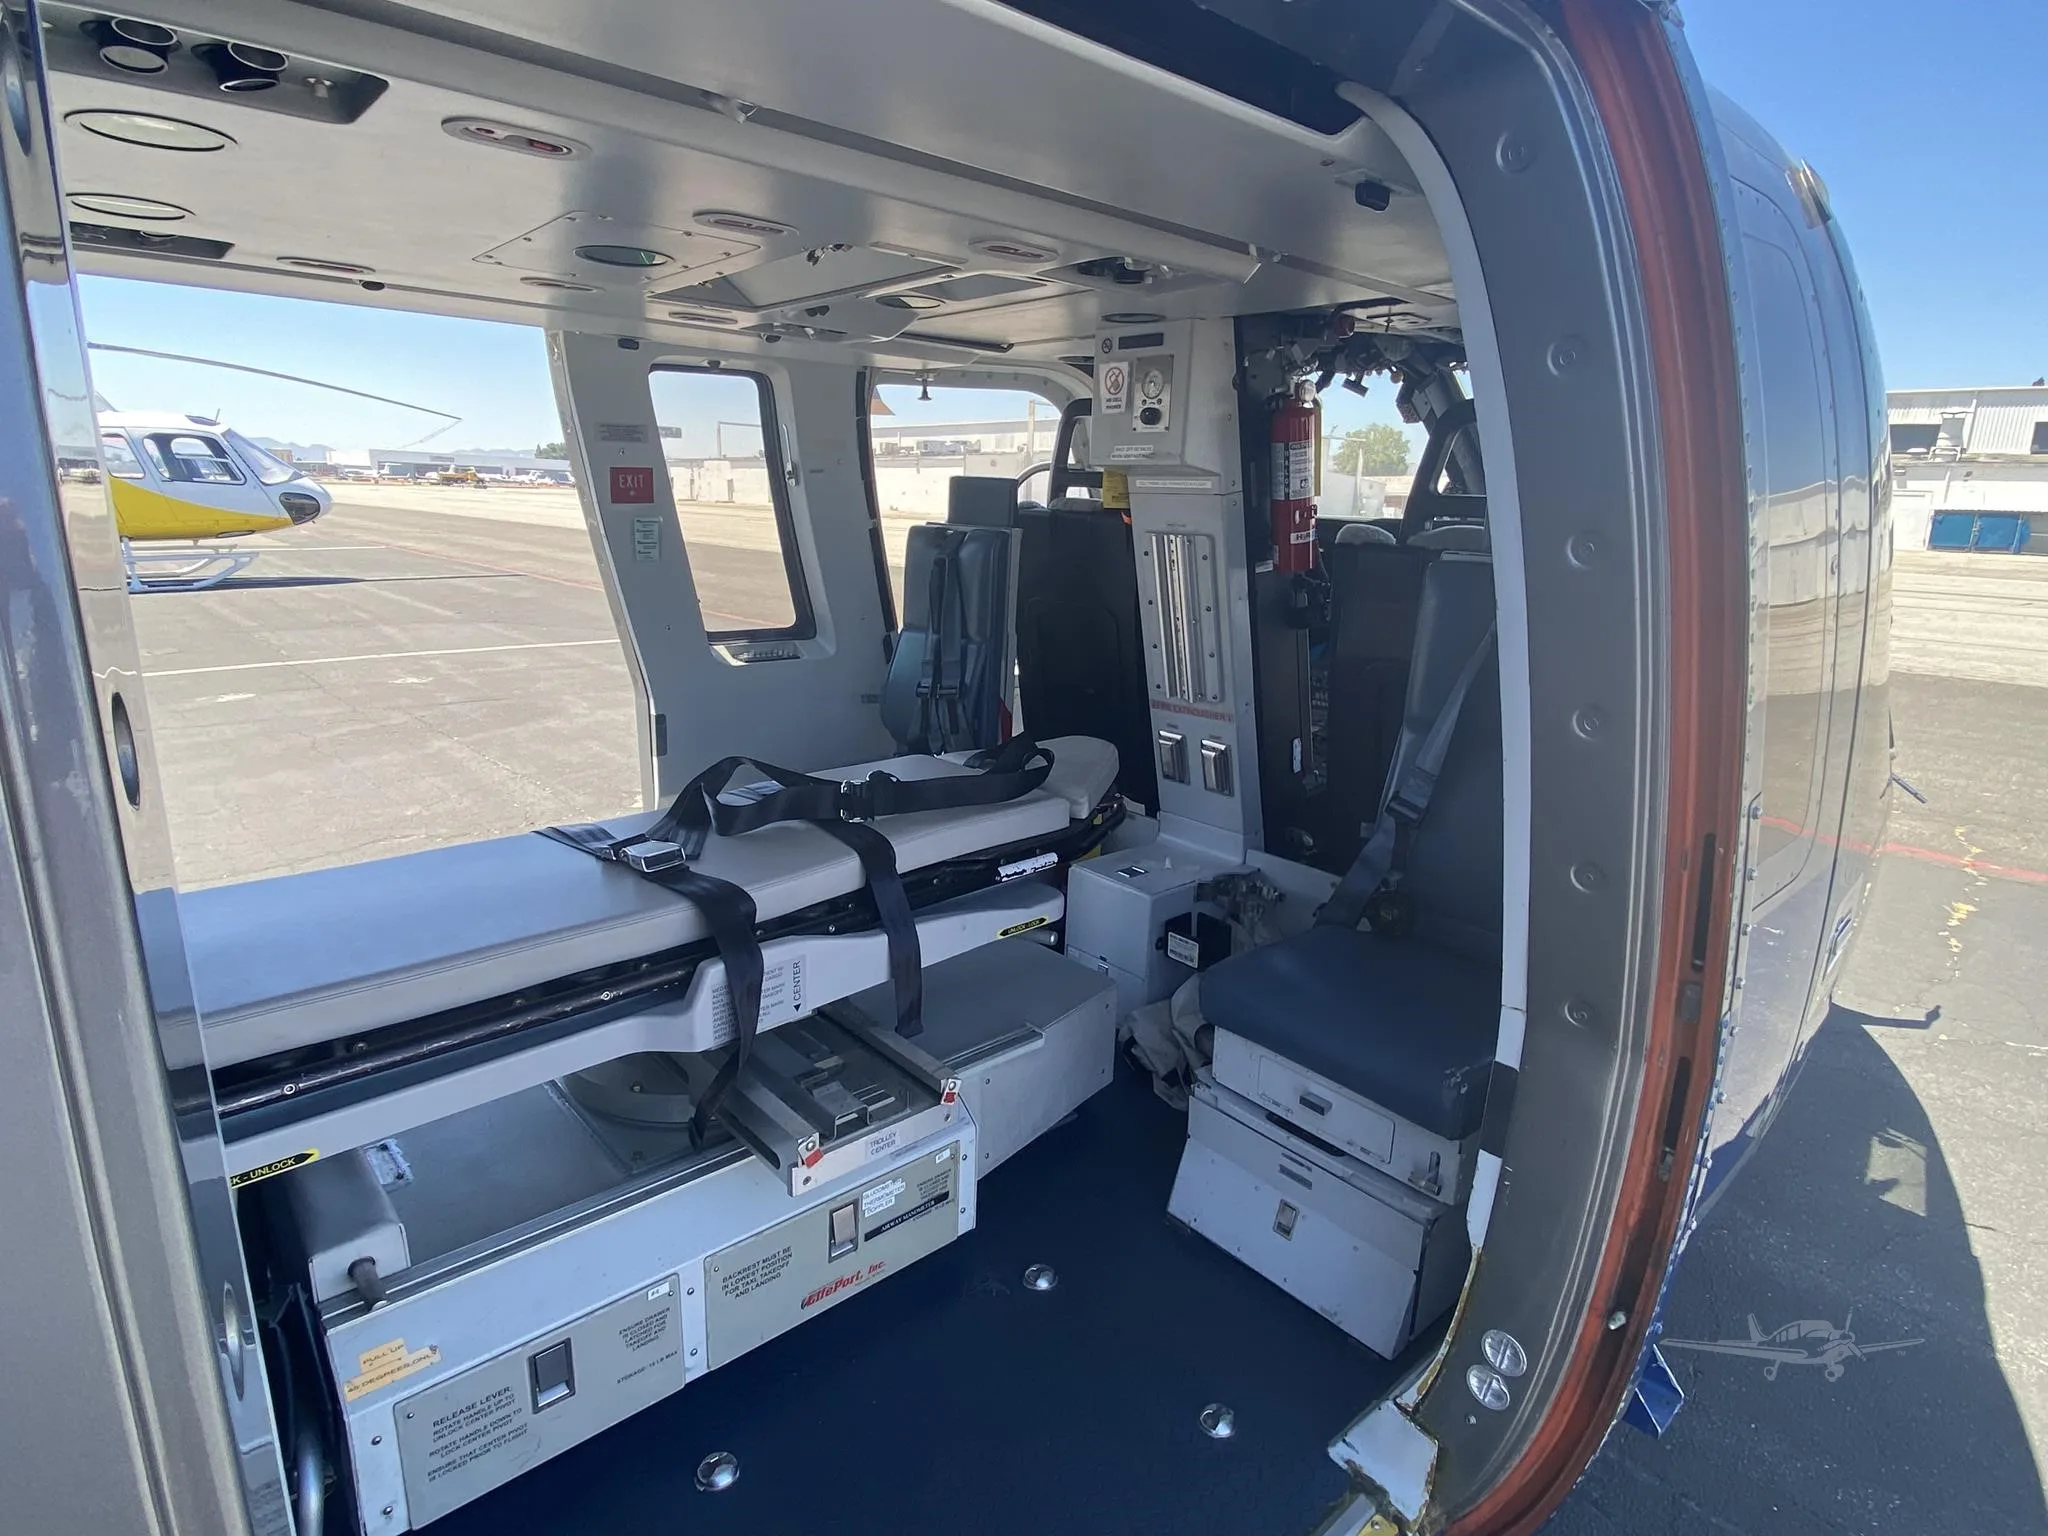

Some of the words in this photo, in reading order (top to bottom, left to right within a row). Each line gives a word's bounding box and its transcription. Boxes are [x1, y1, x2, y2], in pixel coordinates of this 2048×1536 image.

[619, 474, 644, 488] EXIT
[793, 960, 801, 1001] CENTER
[870, 1131, 897, 1148] TROLLEY
[870, 1140, 896, 1156] CENTER
[250, 1157, 296, 1179] UNLOCK
[722, 1262, 761, 1284] BACKREST
[761, 1252, 782, 1266] MUST
[782, 1246, 792, 1254] BE
[724, 1286, 740, 1297] FOR
[759, 1261, 790, 1280] TAKEOFF
[730, 1271, 759, 1288] LOWEST
[760, 1252, 793, 1272] POSITION
[734, 1288, 750, 1299] AND
[751, 1272, 782, 1292] LANDING
[619, 1319, 644, 1335] ENSURE
[644, 1307, 671, 1323] DRAWER
[625, 1326, 653, 1343] LATCHED
[653, 1320, 667, 1329] FOR
[626, 1333, 652, 1348] TAKEOFF
[654, 1326, 667, 1335] AND
[630, 1320, 654, 1336] CLOSED
[655, 1314, 668, 1323] AND
[632, 1335, 659, 1351] LANDING
[432, 1402, 478, 1428] RELEASE
[480, 1386, 511, 1405] LEVER
[433, 1420, 461, 1436] ROTATE
[463, 1405, 492, 1421] HANDLE
[493, 1399, 504, 1408] UP
[505, 1393, 515, 1401] TO
[433, 1424, 463, 1443] UNLOCK
[465, 1410, 494, 1427] CENTER
[495, 1399, 515, 1415] PIVOT
[427, 1460, 457, 1477] ENSURE
[459, 1449, 476, 1463] THAT
[478, 1433, 507, 1451] CENTER
[507, 1423, 528, 1439] PIVOT
[429, 1440, 457, 1458] ROTATE
[459, 1425, 488, 1443] HANDLE
[489, 1413, 511, 1427] DOWN
[513, 1407, 522, 1416] TO
[440, 1444, 461, 1458] LOCK
[462, 1429, 492, 1446] CENTER
[493, 1419, 513, 1435] PIVOT
[438, 1458, 468, 1477] LOCKED
[469, 1447, 492, 1462] PRIOR
[493, 1441, 503, 1450] TO
[503, 1428, 528, 1446] FLIGHT
